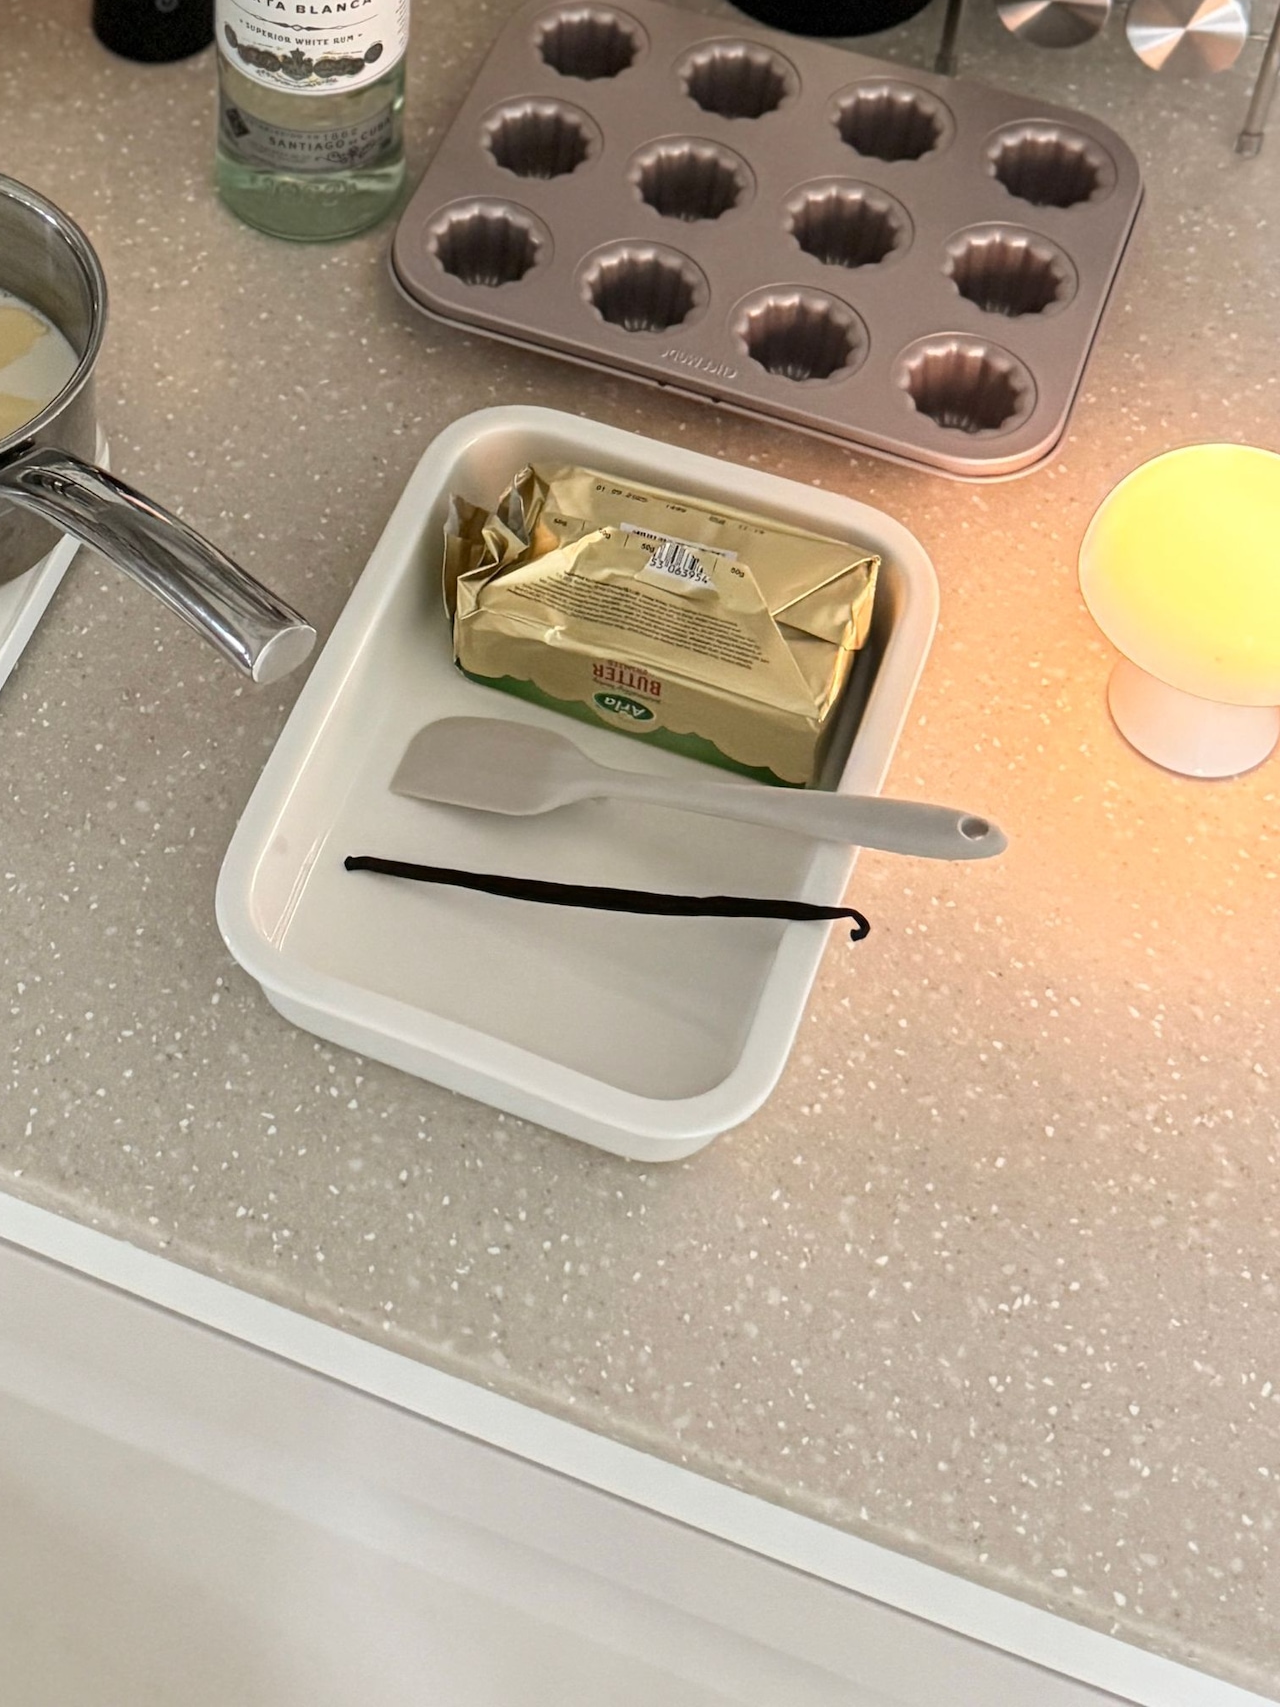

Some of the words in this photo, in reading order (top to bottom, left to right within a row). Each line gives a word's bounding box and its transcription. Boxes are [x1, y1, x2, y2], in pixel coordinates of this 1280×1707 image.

[246, 22, 291, 44] SUPERIOR
[295, 37, 329, 46] WHITE
[334, 34, 354, 45] RUM
[269, 136, 345, 152] SANTIAGO
[361, 117, 392, 141] CUBA
[593, 663, 662, 697] BUTTER
[604, 696, 646, 717] Arla
